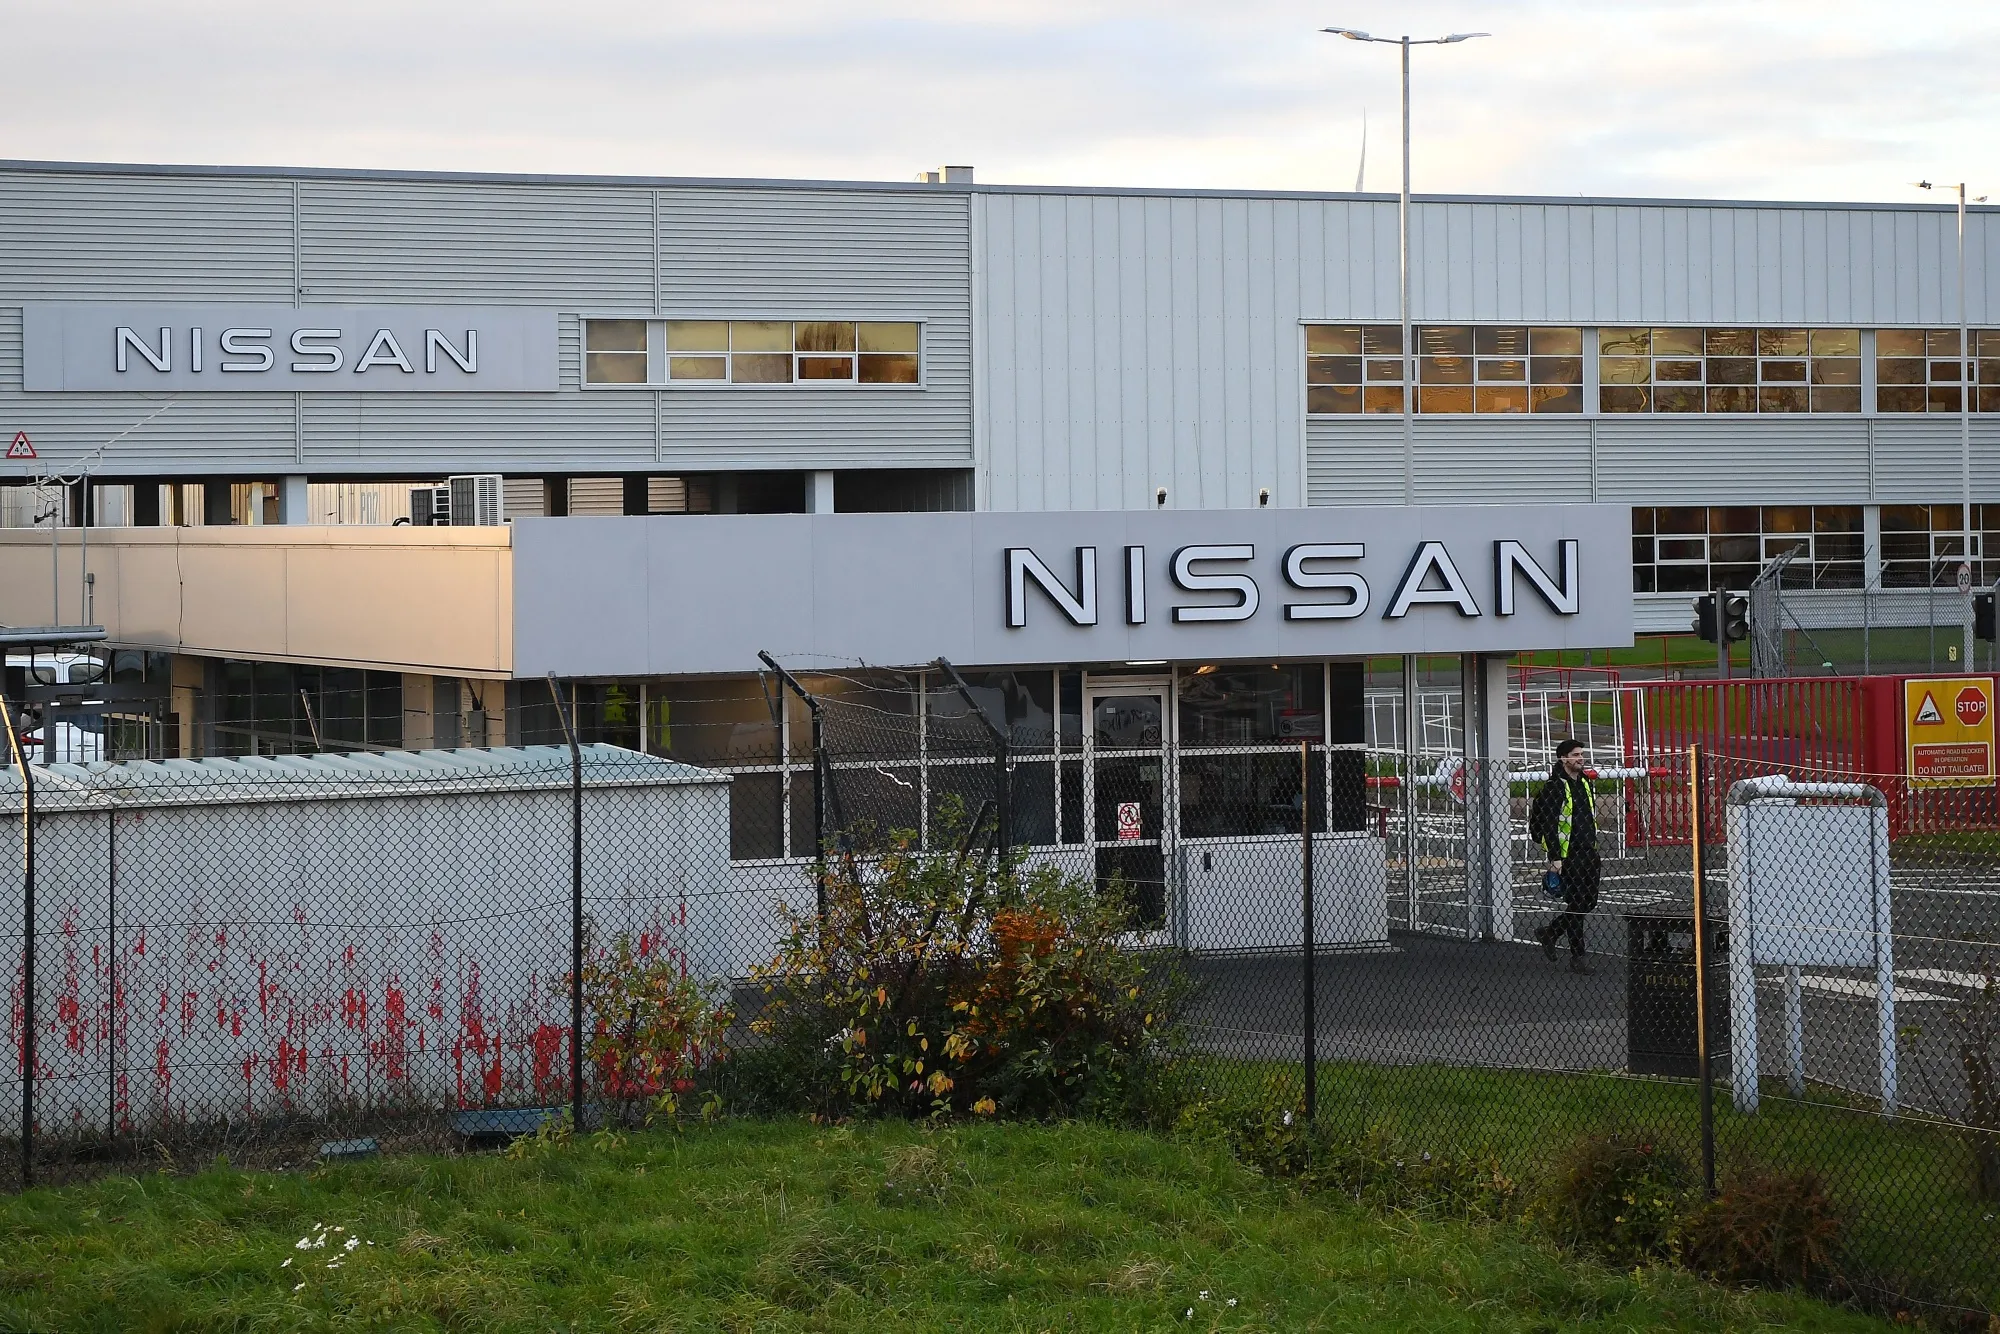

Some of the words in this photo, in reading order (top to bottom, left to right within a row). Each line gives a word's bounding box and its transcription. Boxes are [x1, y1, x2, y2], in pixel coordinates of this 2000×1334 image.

[115, 325, 479, 374] NISSAN
[1004, 539, 1581, 628] NISSAN
[1959, 573, 1969, 585] 20
[1957, 701, 1985, 712] STOP
[1918, 766, 1930, 775] DO
[1931, 766, 1947, 774] NOT
[1948, 764, 1985, 774] TAILGATE!
